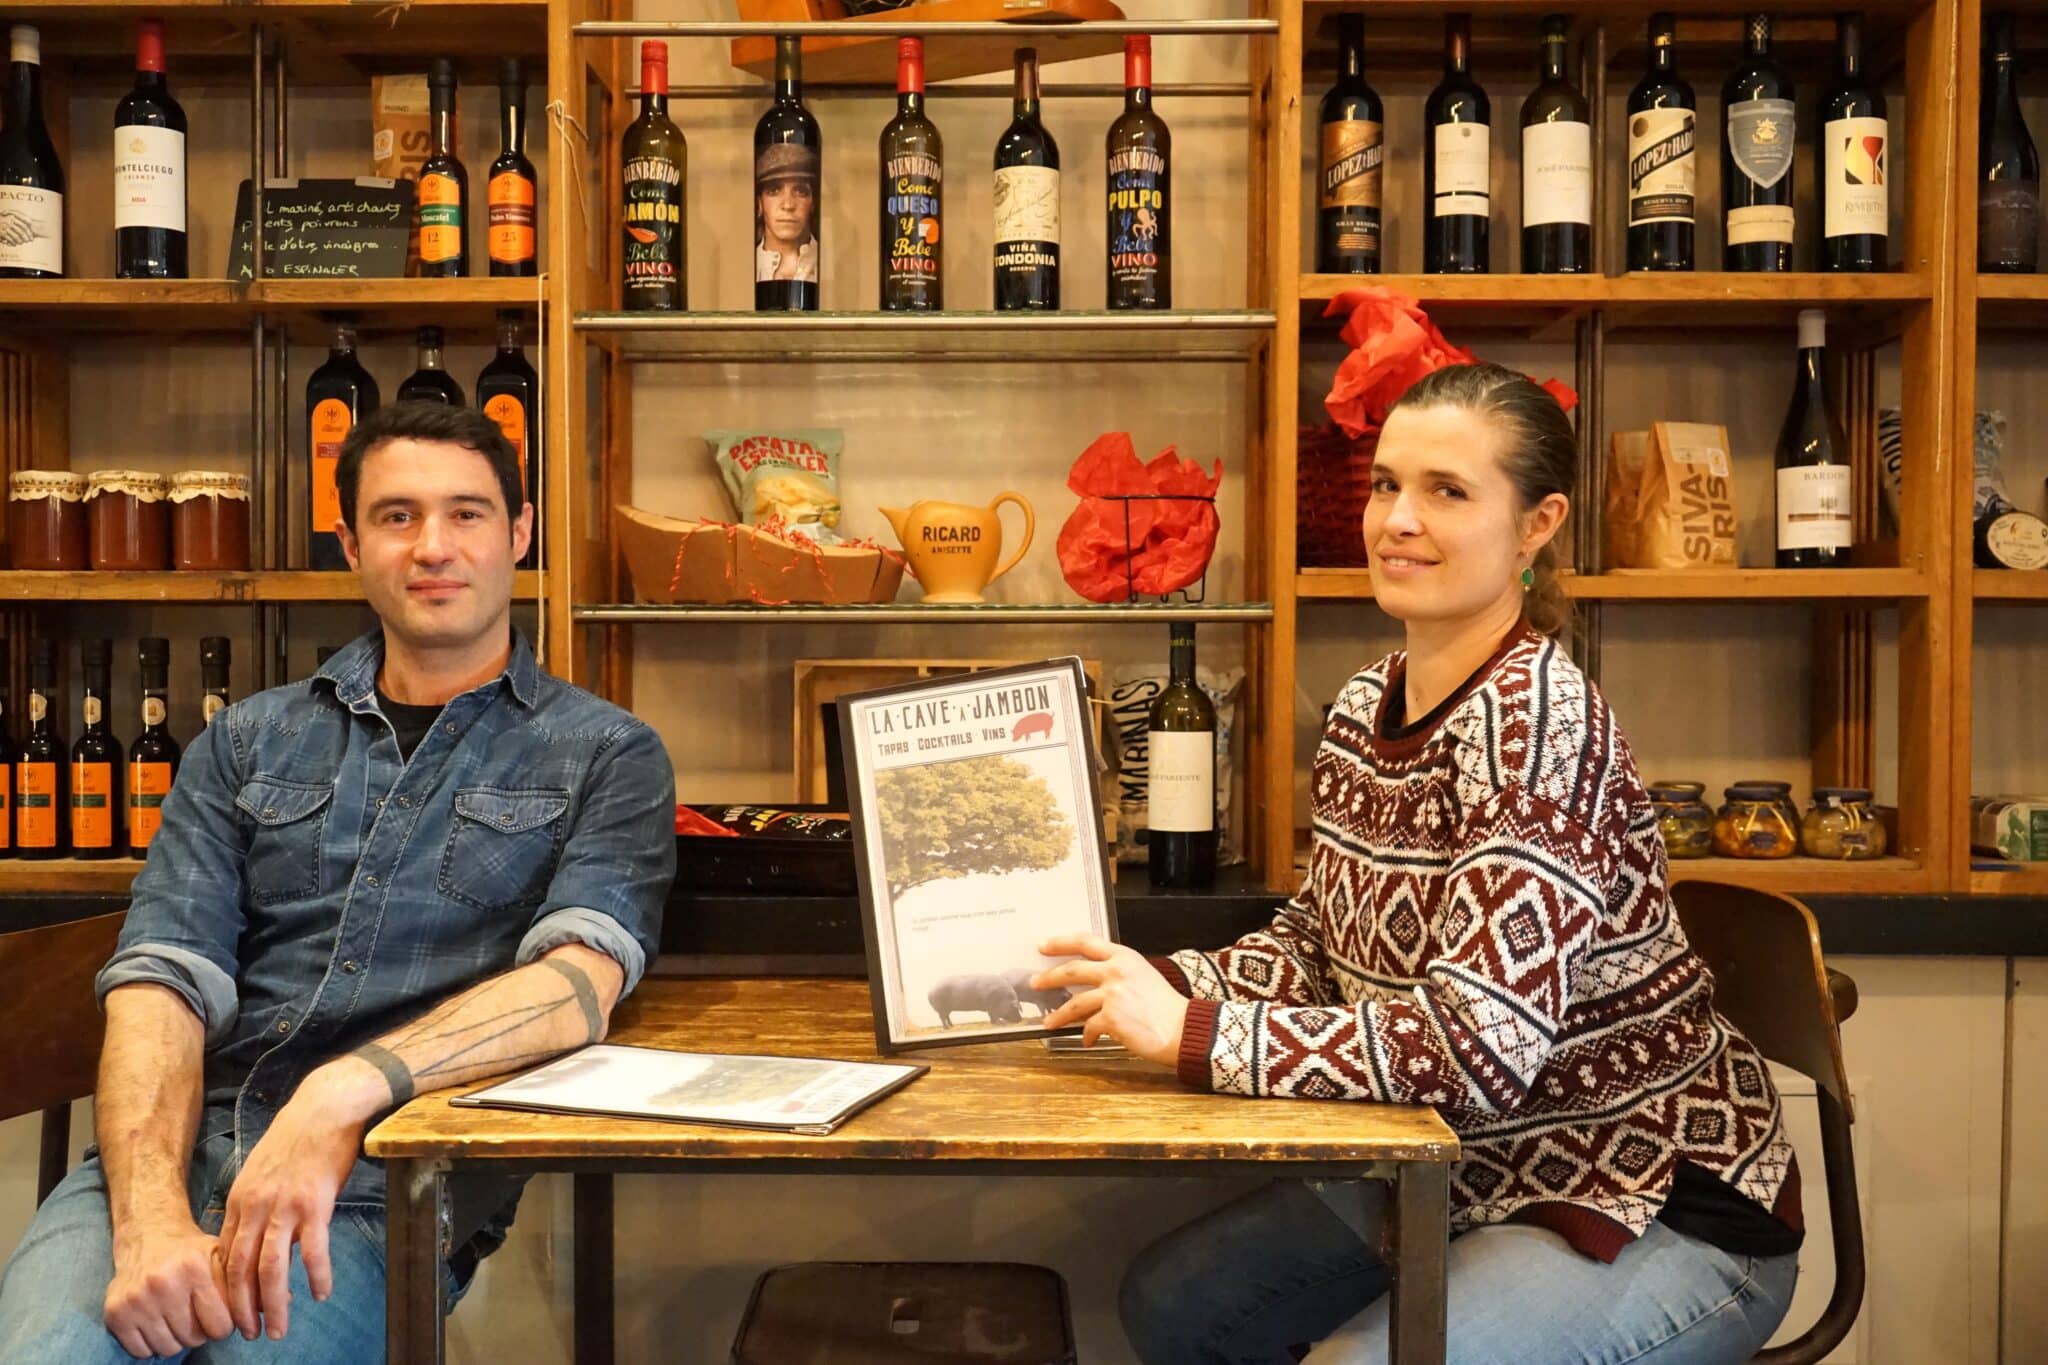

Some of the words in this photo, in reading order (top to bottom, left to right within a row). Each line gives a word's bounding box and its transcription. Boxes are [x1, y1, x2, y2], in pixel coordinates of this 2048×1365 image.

[897, 178, 932, 195] Come
[0, 191, 44, 202] PACTO
[888, 195, 938, 215] QUESO
[1109, 189, 1162, 211] PULPO
[893, 238, 931, 256] Bebe
[1009, 242, 1037, 252] VIÑA
[626, 261, 674, 275] VINO
[891, 257, 936, 272] VINO
[995, 253, 1056, 267] TONDONIA
[1111, 252, 1158, 268] VINO
[1707, 475, 1735, 538] RIS
[923, 526, 981, 542] RICARD
[871, 709, 894, 735] LA
[902, 700, 950, 730] CAVE
[973, 685, 1051, 719] JAMBON
[878, 741, 909, 757] TAPAS
[918, 732, 973, 751] COCKTAILS
[982, 727, 1006, 742] VINS
[1112, 679, 1160, 801] MARINAS
